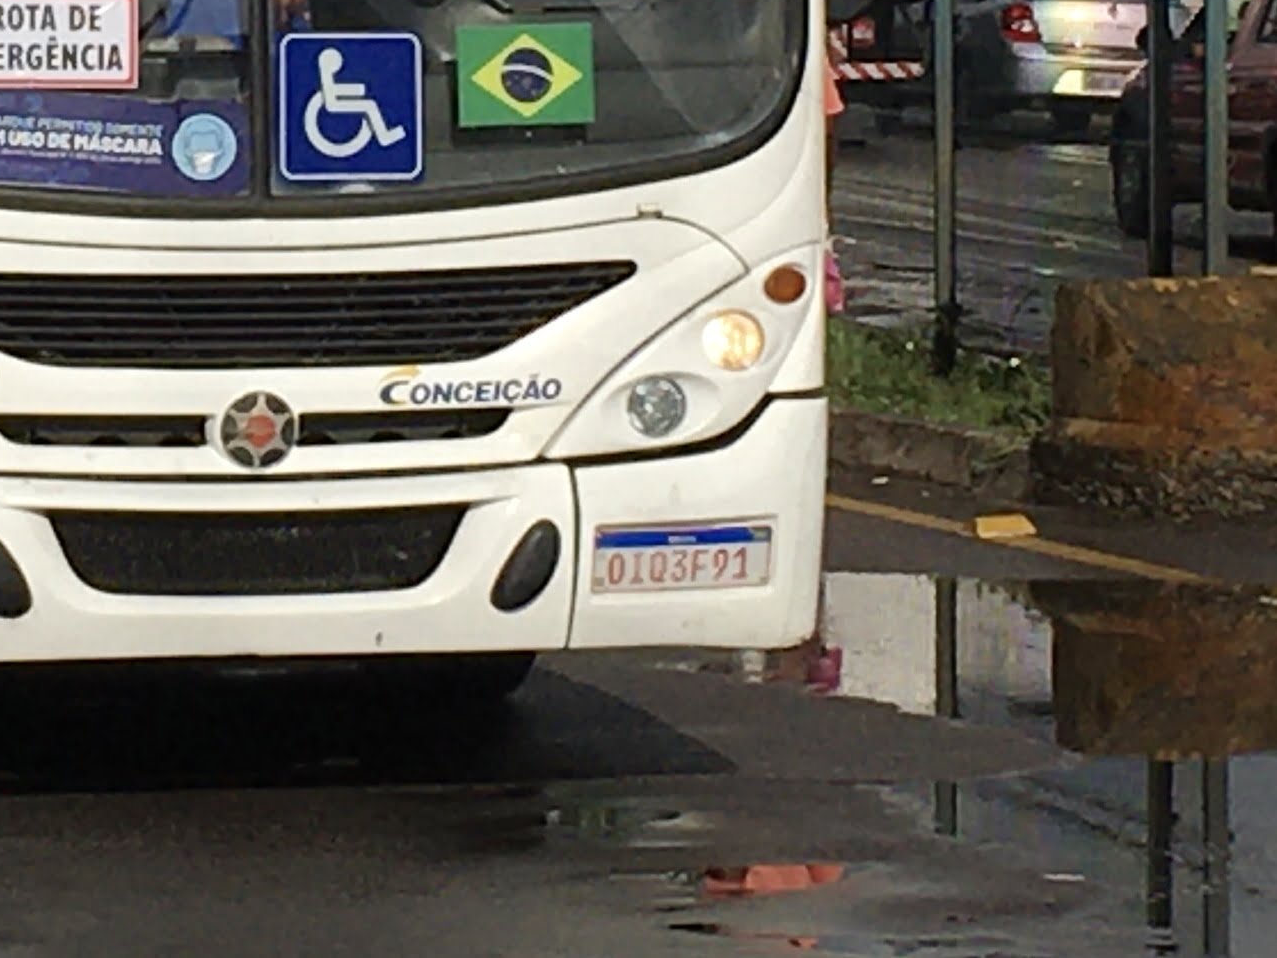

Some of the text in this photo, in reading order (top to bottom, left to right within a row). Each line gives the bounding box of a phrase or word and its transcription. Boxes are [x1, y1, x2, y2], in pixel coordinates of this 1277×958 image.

[69, 4, 101, 31] DE
[8, 130, 45, 148] USO
[47, 132, 71, 149] DE
[74, 133, 163, 155] MÁSCARA
[380, 373, 562, 406] CONCEIÇÃO
